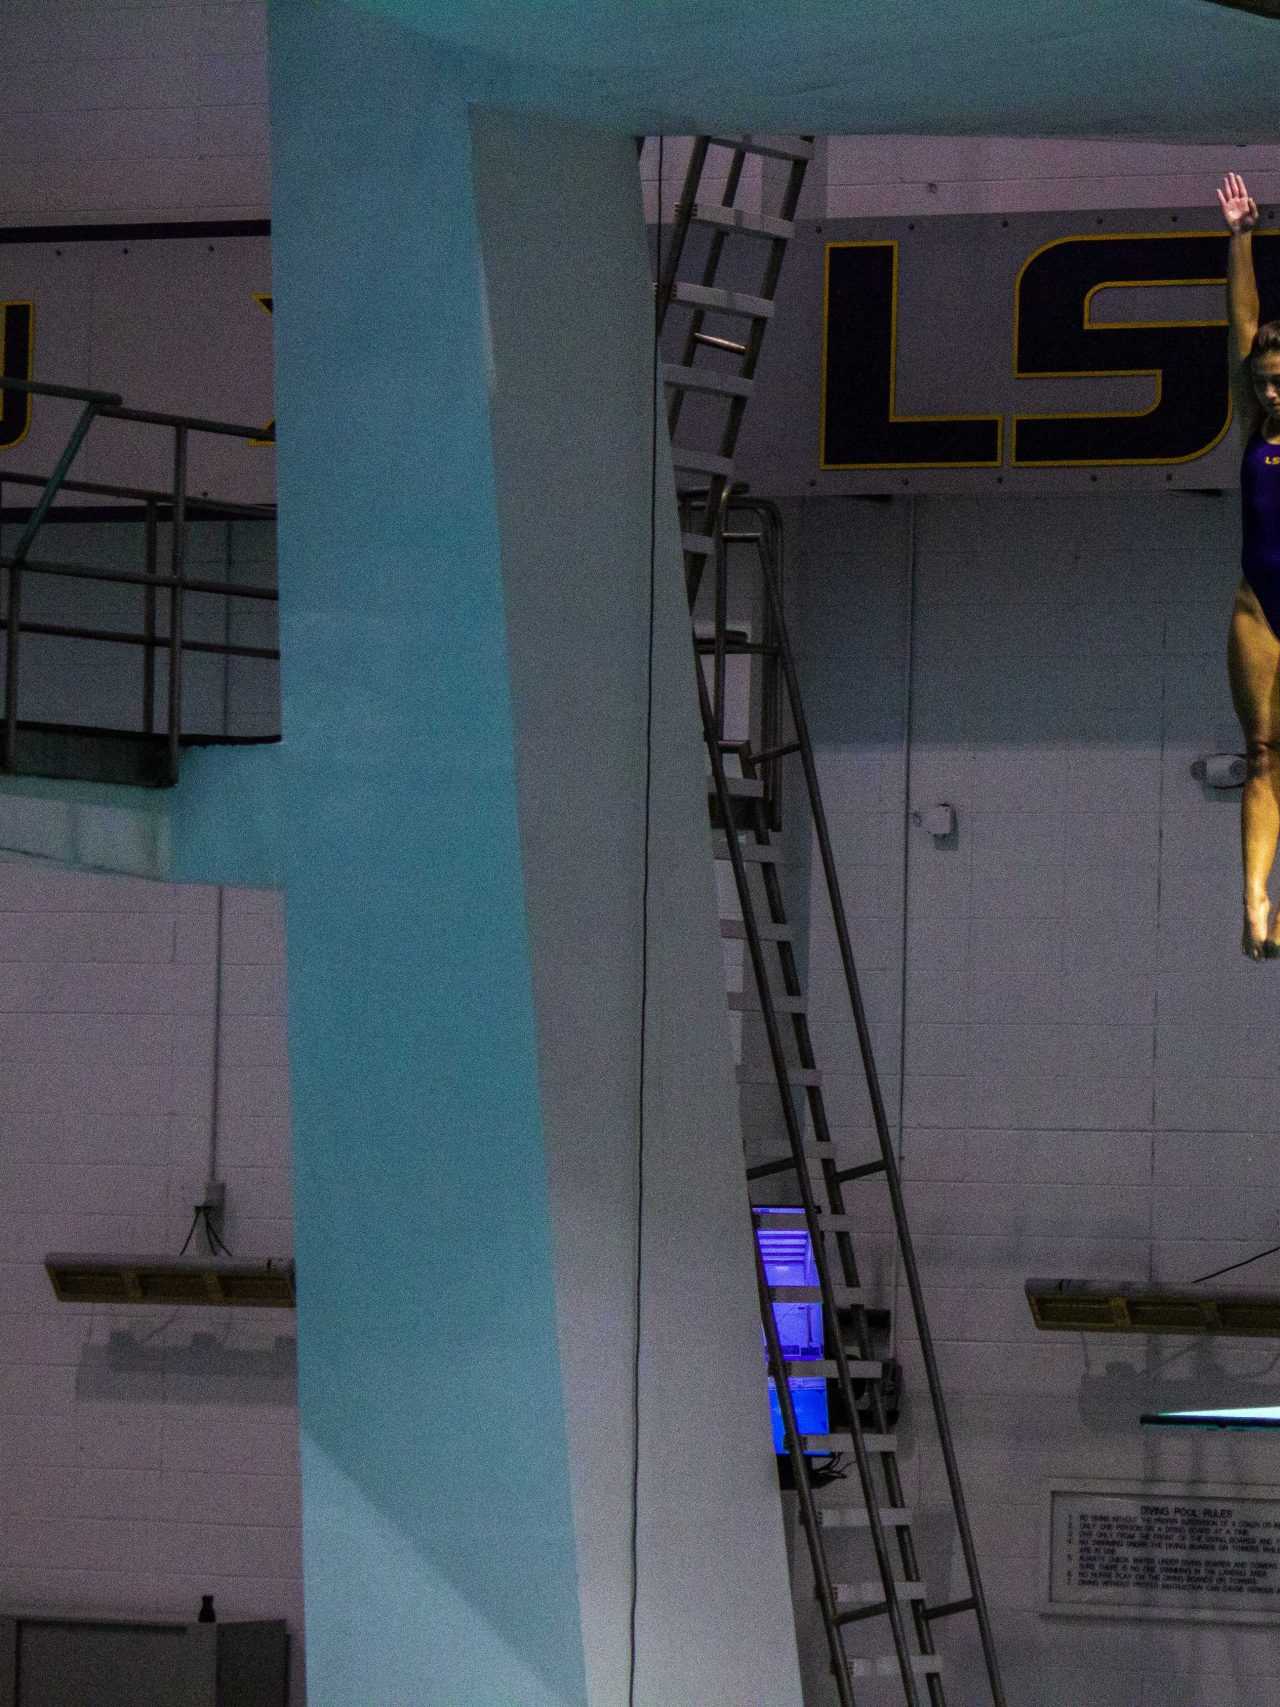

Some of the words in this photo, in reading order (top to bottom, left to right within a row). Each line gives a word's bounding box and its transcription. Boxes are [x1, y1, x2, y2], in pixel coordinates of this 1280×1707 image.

[1141, 1506, 1170, 1516] DIVING
[1174, 1507, 1199, 1517] POOL
[1203, 1508, 1232, 1518] RULES
